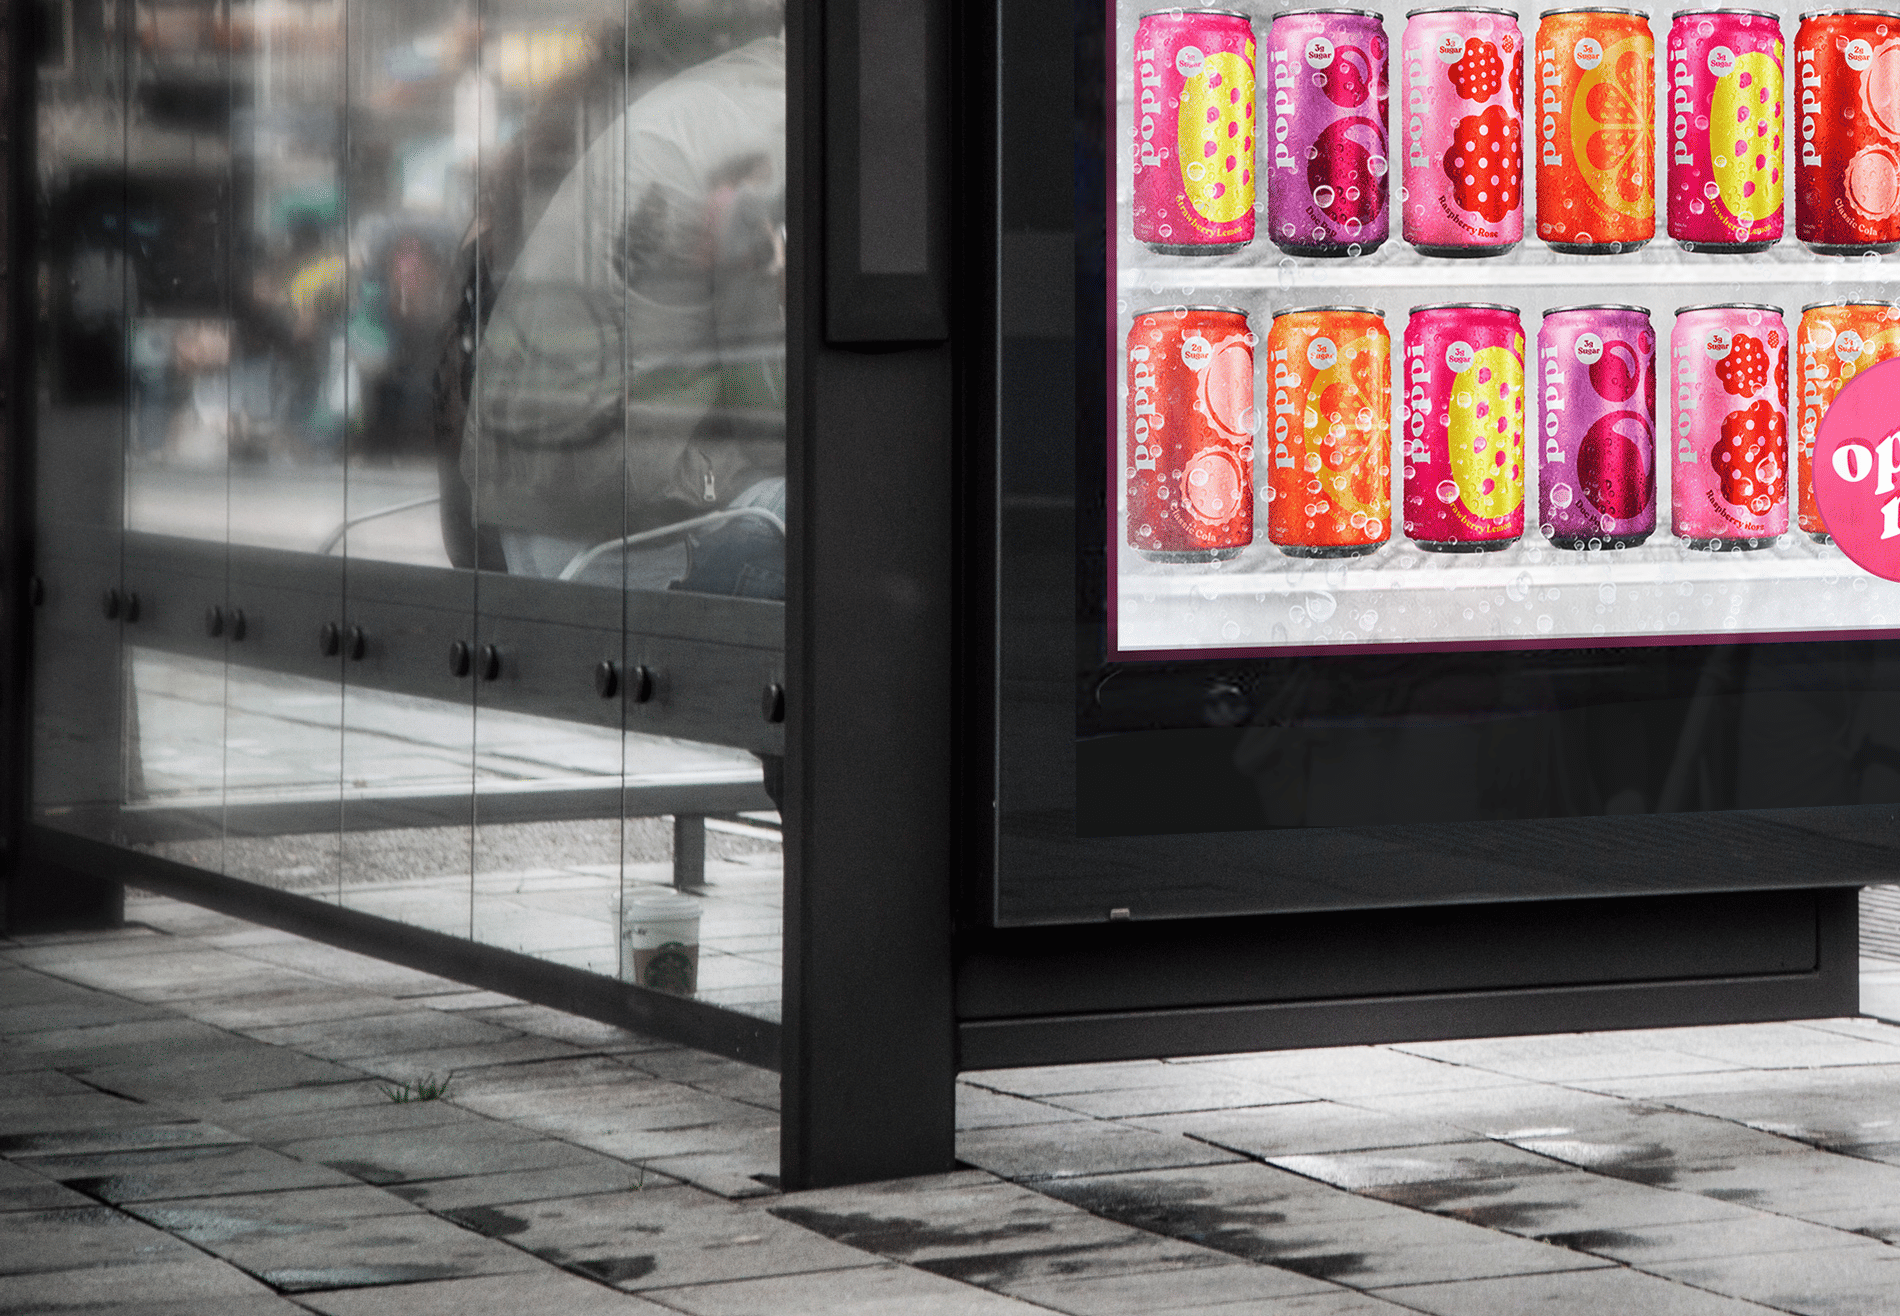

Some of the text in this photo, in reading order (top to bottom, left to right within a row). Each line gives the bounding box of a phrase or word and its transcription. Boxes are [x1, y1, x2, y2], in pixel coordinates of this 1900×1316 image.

[1315, 44, 1324, 52] 3g
[1440, 46, 1462, 54] Sugar
[1583, 45, 1593, 53] 3g
[1854, 46, 1864, 54] 2g
[1308, 51, 1331, 60] Sugar
[1577, 52, 1600, 60] Sugar
[1848, 53, 1870, 61] Sugar
[1711, 60, 1732, 68] Sugar
[1137, 48, 1161, 167] poppi
[1271, 49, 1295, 168] poppi
[1406, 48, 1429, 168] poppi
[1538, 48, 1562, 167] poppi
[1671, 48, 1693, 166] poppi
[1798, 49, 1821, 167] poppi
[1176, 195, 1242, 236] Strawberry Lemon
[1306, 206, 1320, 225] Doc
[1438, 195, 1498, 238] Raspberry Rose
[1835, 198, 1857, 229] Classic
[1858, 224, 1877, 236] Cola
[1713, 335, 1722, 343] 3g
[1191, 344, 1202, 352] 2g
[1455, 348, 1464, 356] 3g
[1578, 347, 1600, 355] Sugar
[1707, 343, 1729, 351] Sugar
[1185, 351, 1208, 360] Sugar
[1449, 355, 1471, 363] Sugar
[1130, 345, 1156, 472] poppi
[1271, 348, 1295, 469] poppi
[1407, 344, 1431, 464] poppi
[1542, 346, 1565, 464] poppi
[1674, 346, 1697, 464] poppi
[1706, 490, 1744, 529] Raspberry
[1486, 522, 1511, 533] Lemon
[1196, 530, 1216, 541] Cola
